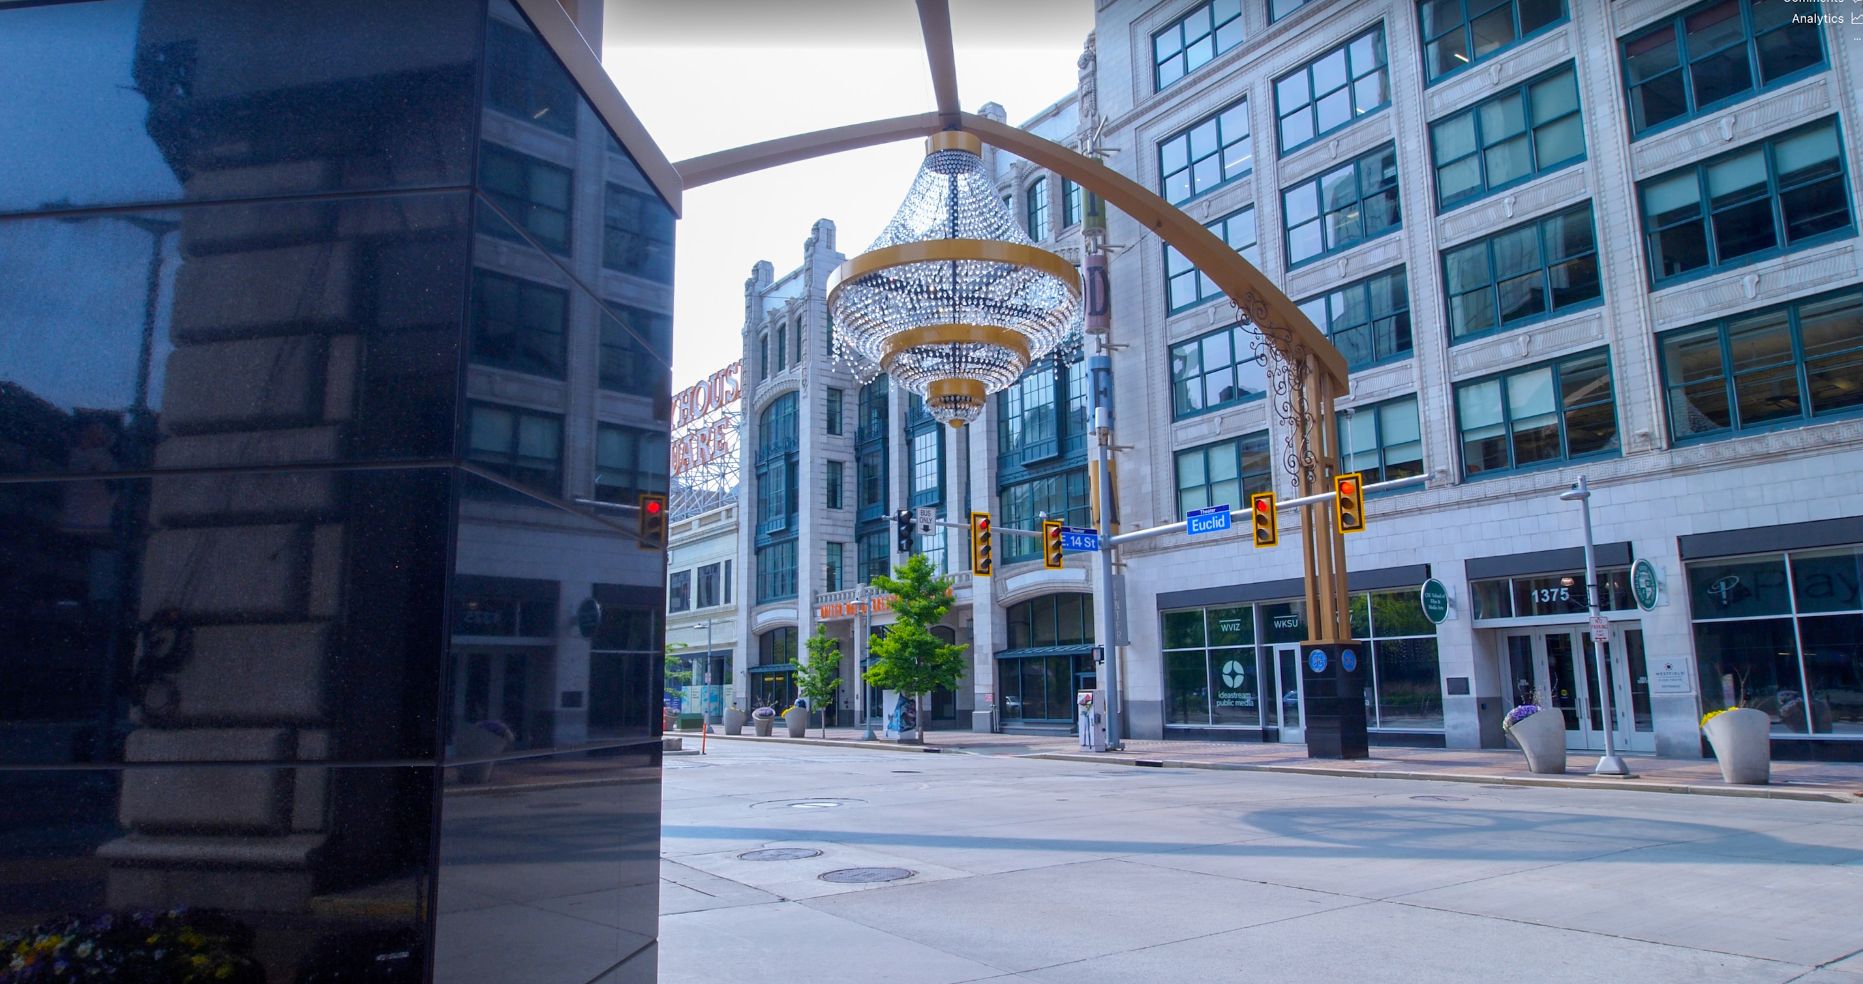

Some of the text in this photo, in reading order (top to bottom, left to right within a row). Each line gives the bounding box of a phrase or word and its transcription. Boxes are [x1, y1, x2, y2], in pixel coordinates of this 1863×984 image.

[671, 359, 743, 432] HOUS
[1191, 514, 1226, 532] Euclid
[1070, 535, 1083, 548] 14
[1083, 536, 1096, 549] St
[1531, 587, 1570, 603] 1375
[1220, 623, 1241, 632] WVIZ
[1273, 619, 1298, 629] WKSU
[1218, 691, 1251, 699] ideastream
[1216, 699, 1254, 708] public media
